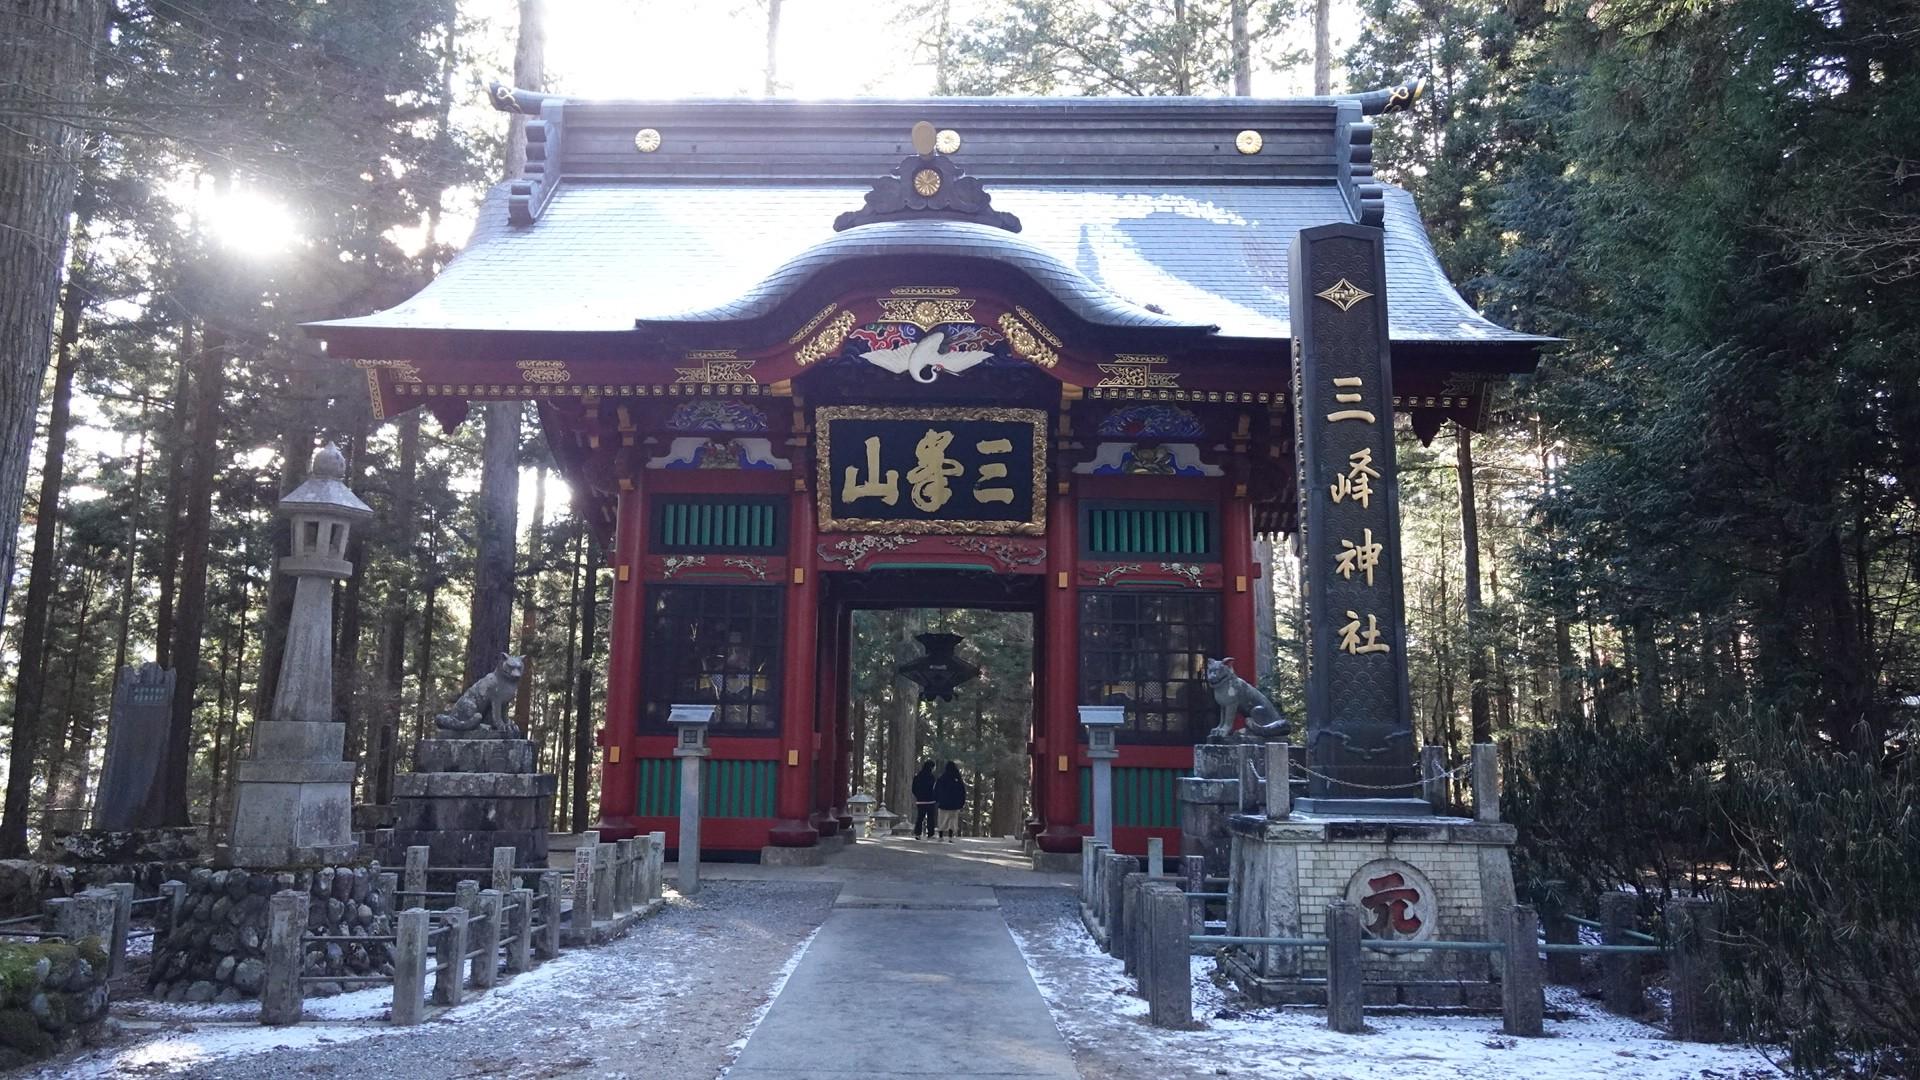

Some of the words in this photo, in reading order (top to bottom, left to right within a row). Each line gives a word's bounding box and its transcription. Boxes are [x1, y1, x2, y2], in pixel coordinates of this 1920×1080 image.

[1327, 377, 1390, 655] 三峰神社
[1361, 873, 1422, 934] 元
